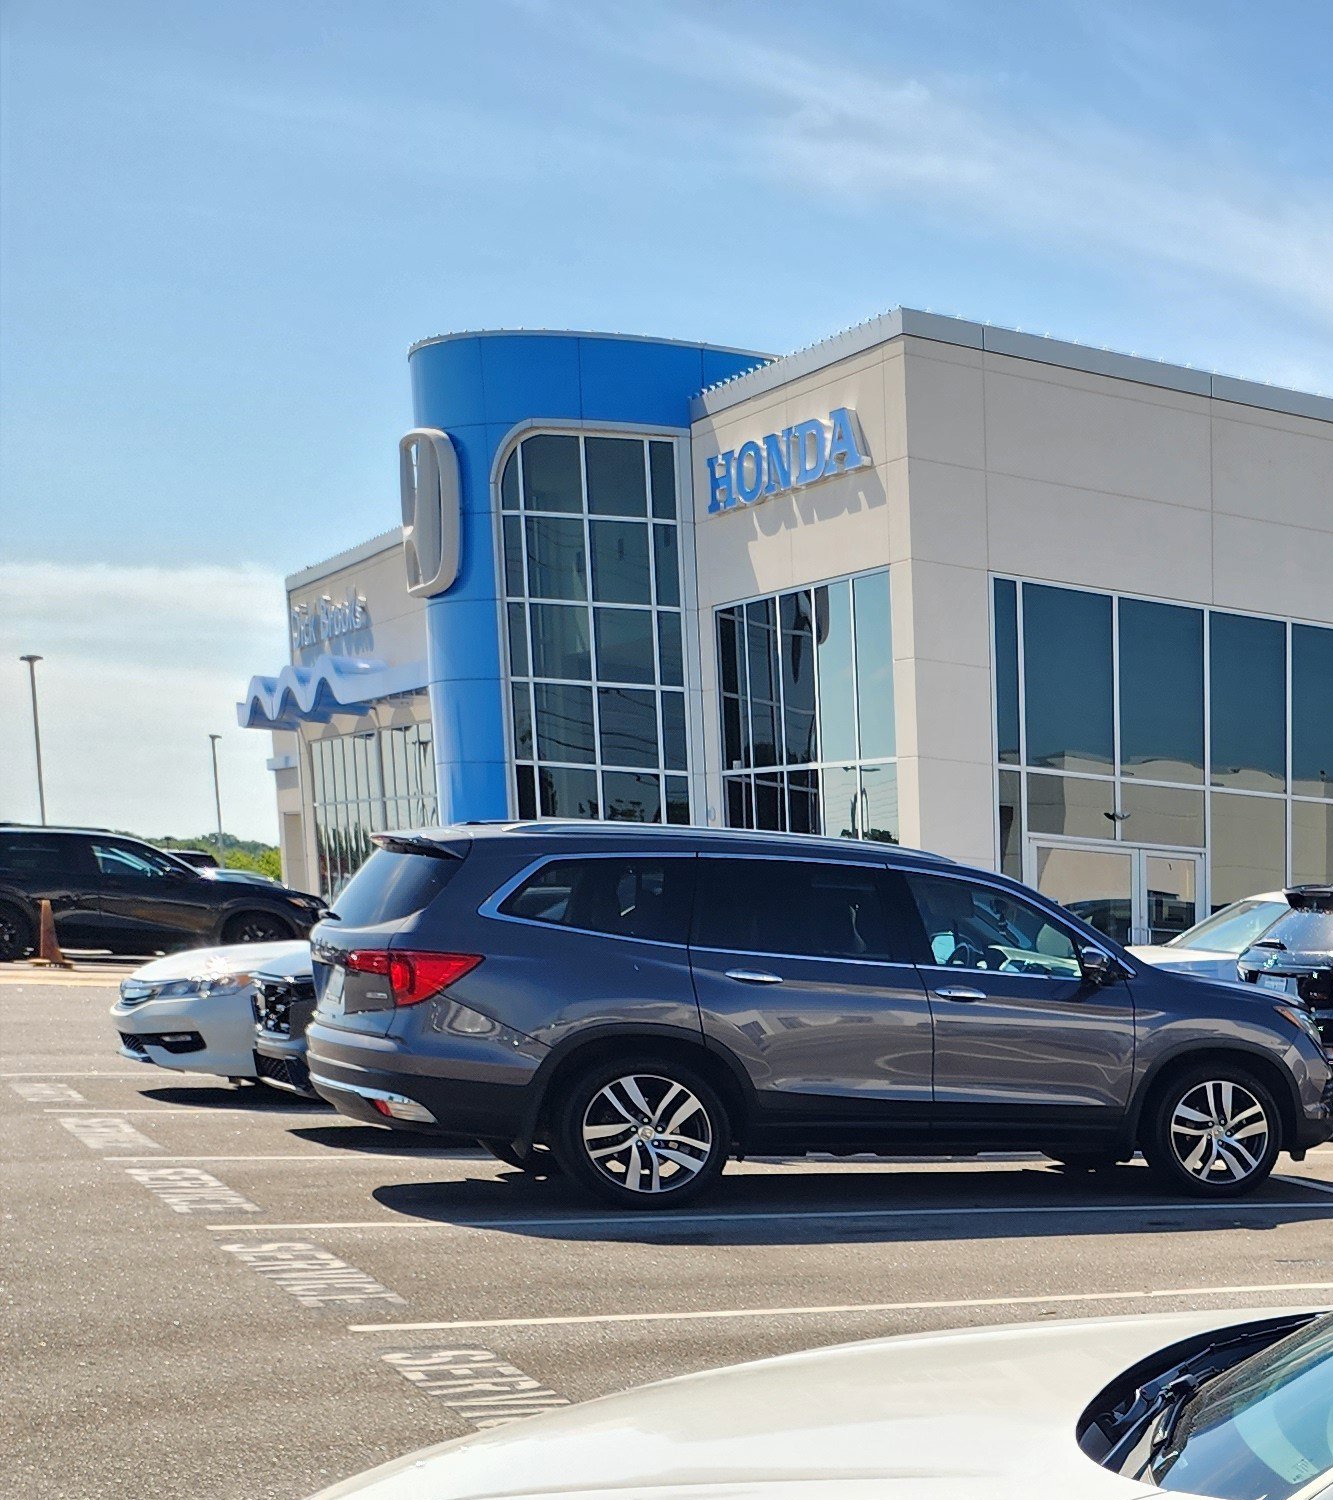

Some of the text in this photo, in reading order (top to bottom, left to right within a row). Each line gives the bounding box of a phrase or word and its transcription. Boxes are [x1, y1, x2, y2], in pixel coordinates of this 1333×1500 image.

[706, 407, 868, 514] HONDA
[125, 1167, 263, 1213] SERVICE
[220, 1242, 408, 1307] SERVICE
